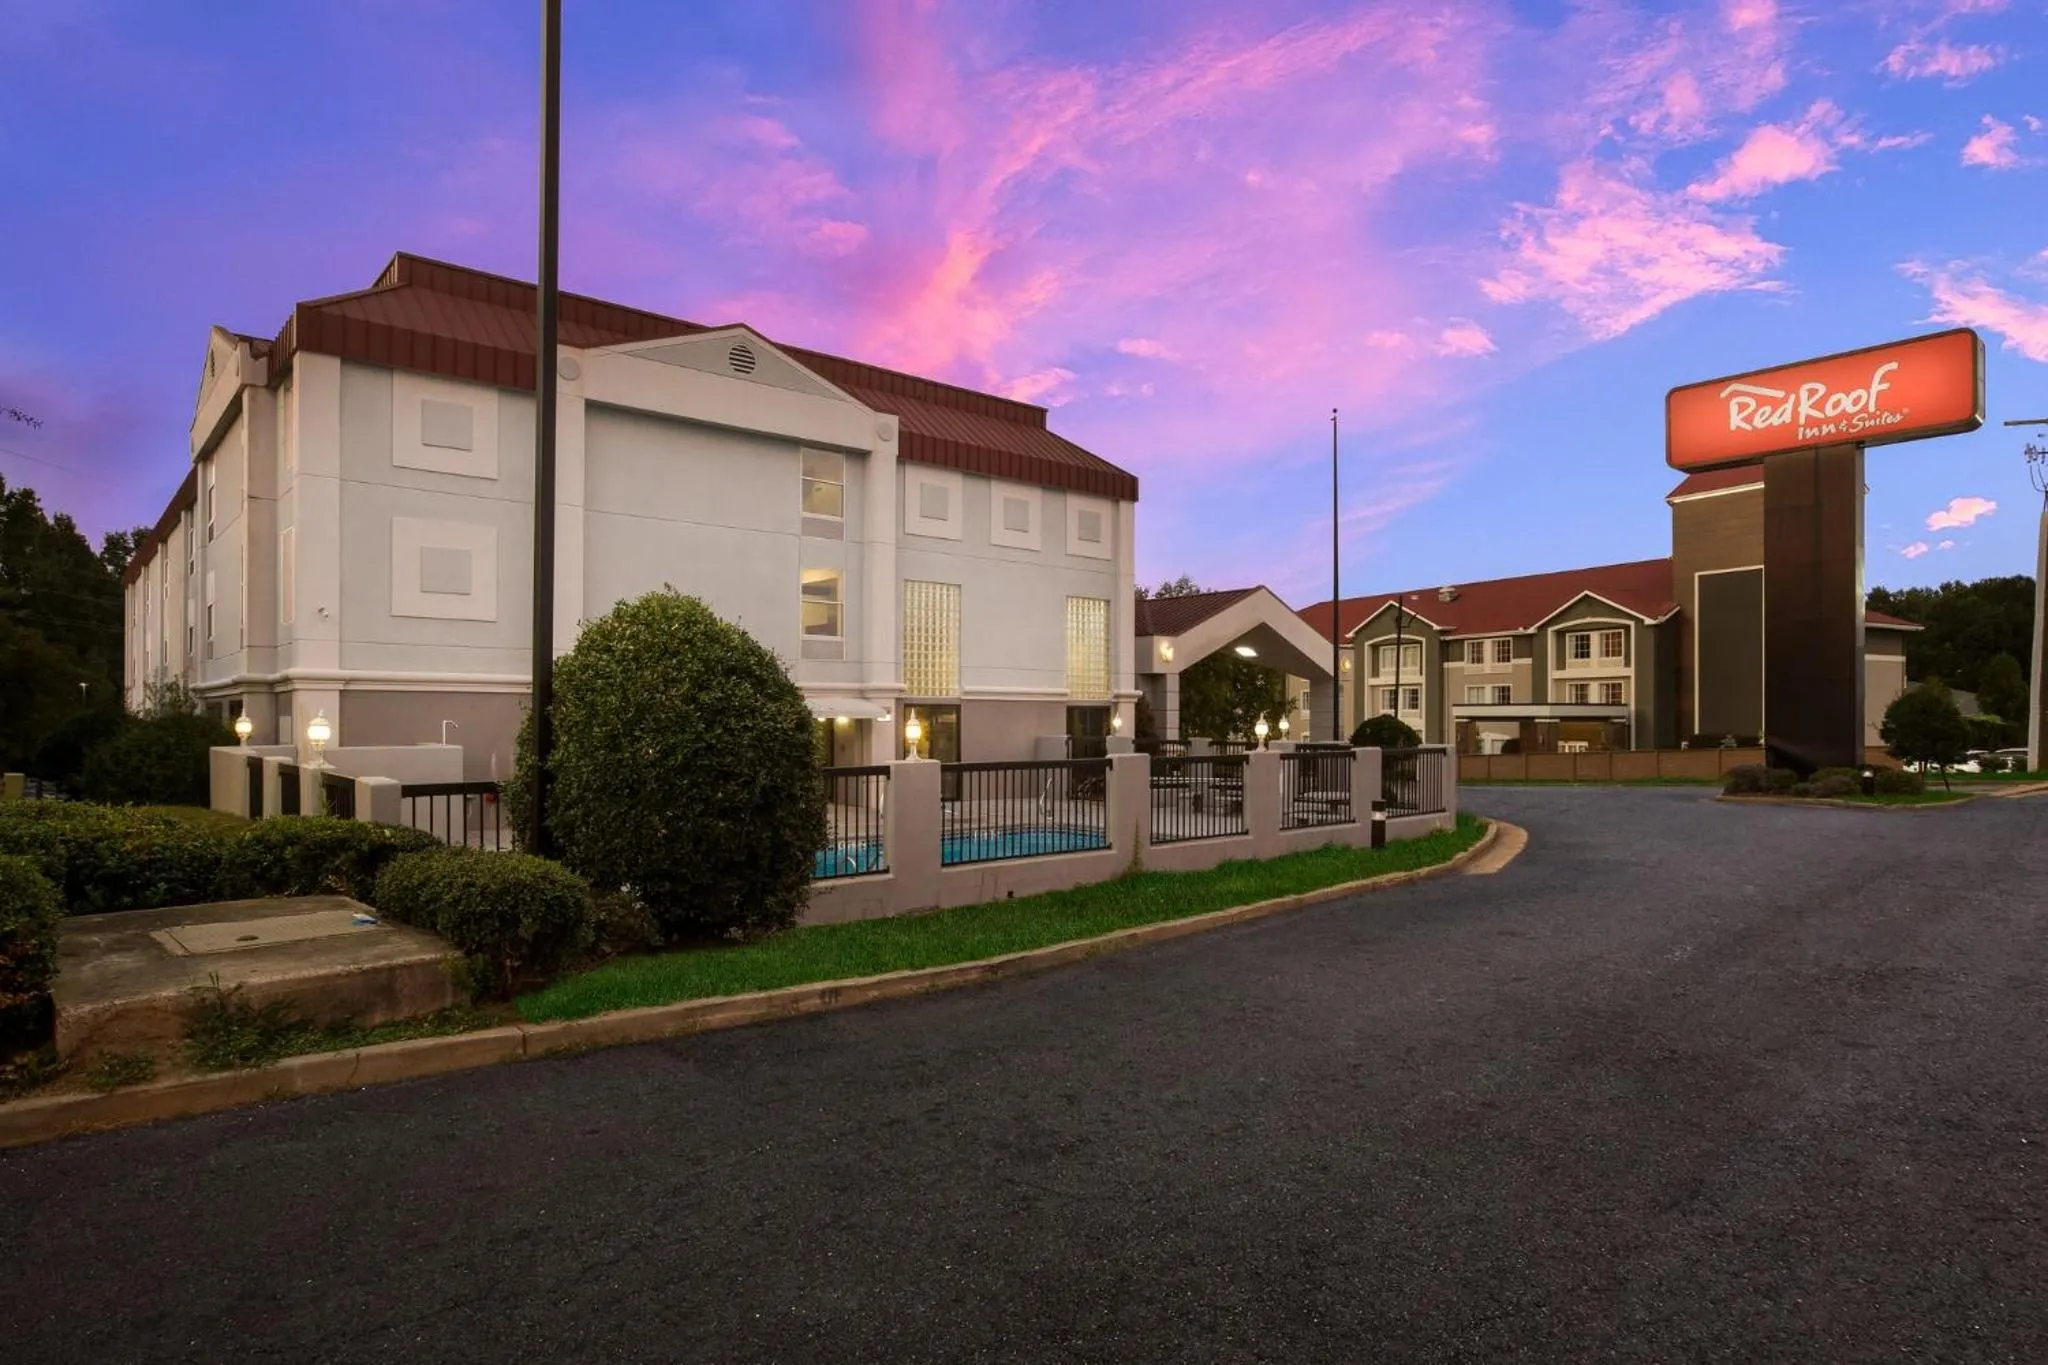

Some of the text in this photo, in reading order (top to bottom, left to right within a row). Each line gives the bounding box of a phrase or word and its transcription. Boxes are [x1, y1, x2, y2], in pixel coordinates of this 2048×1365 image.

[1729, 362, 1899, 431] Red Roof
[1839, 419, 1848, 431] &
[1849, 410, 1904, 433] Suites
